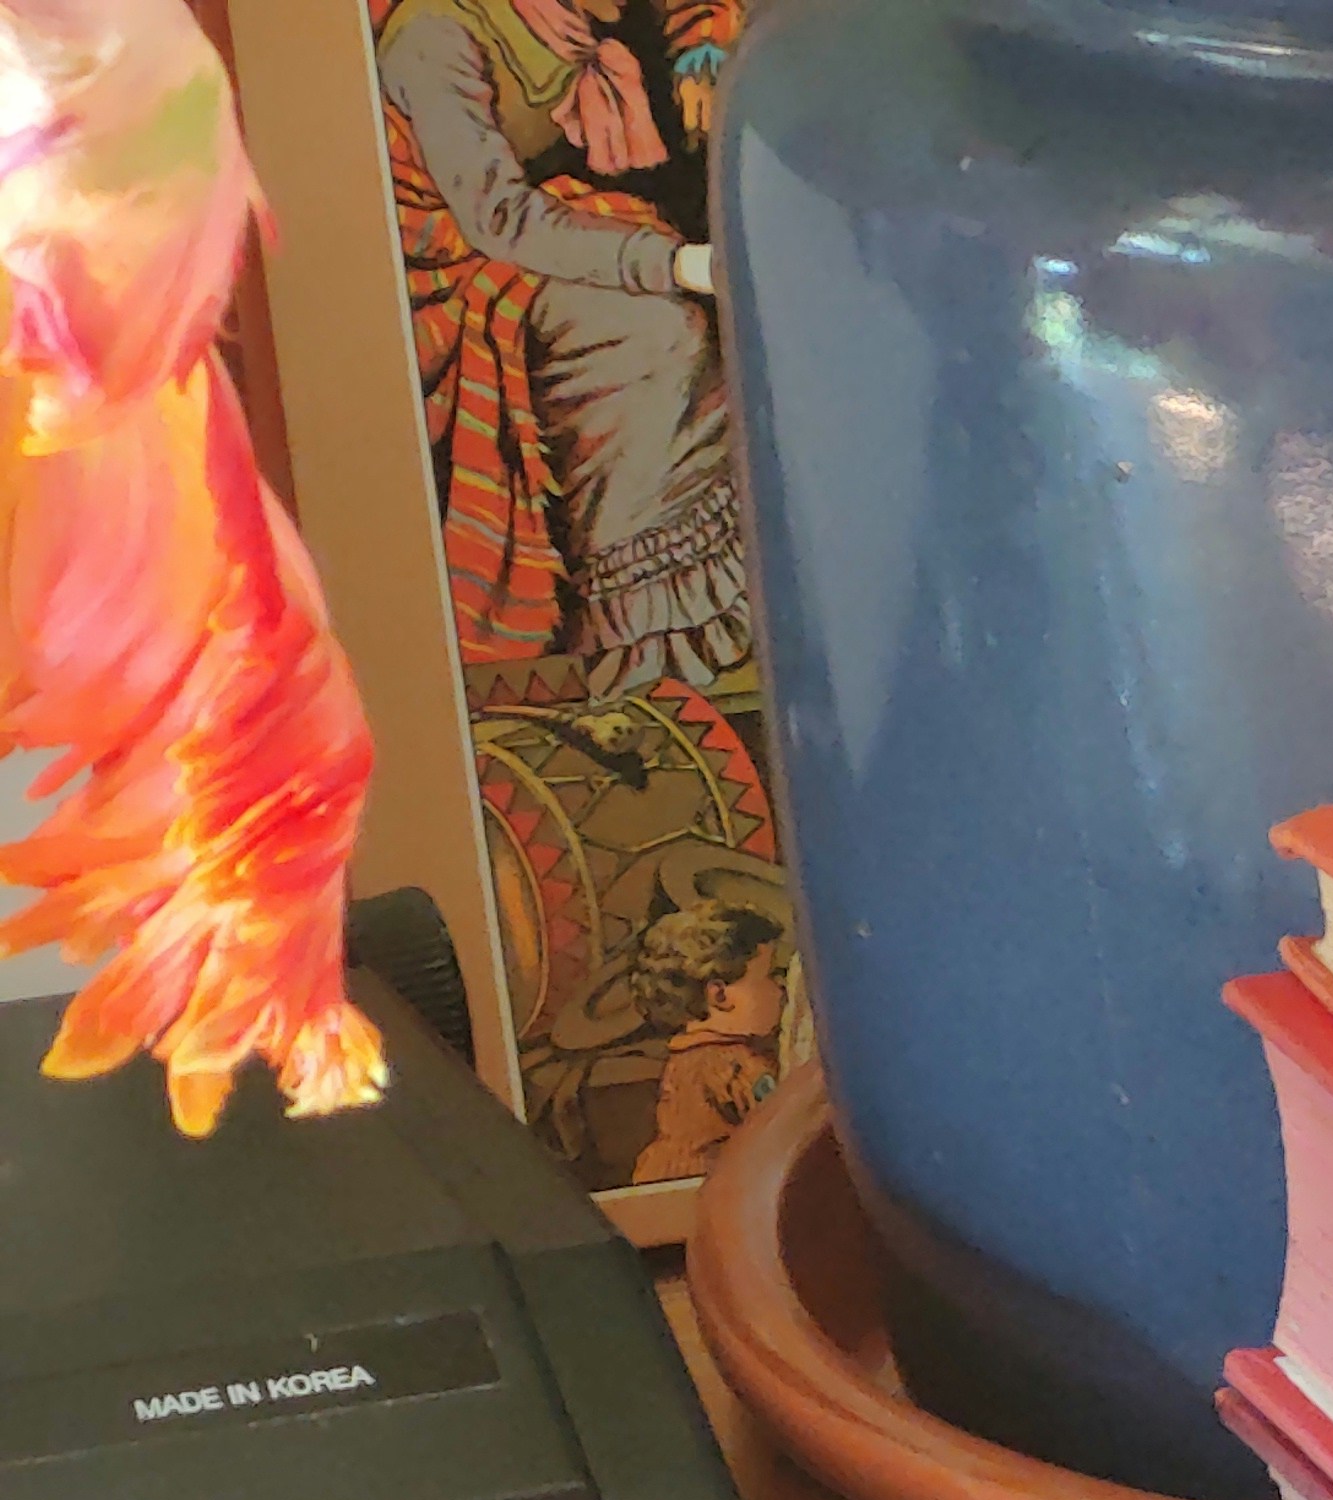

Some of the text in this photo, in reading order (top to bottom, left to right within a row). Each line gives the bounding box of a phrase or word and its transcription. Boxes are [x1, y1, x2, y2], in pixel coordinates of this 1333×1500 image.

[133, 1365, 377, 1421] MADE IN KOREA
